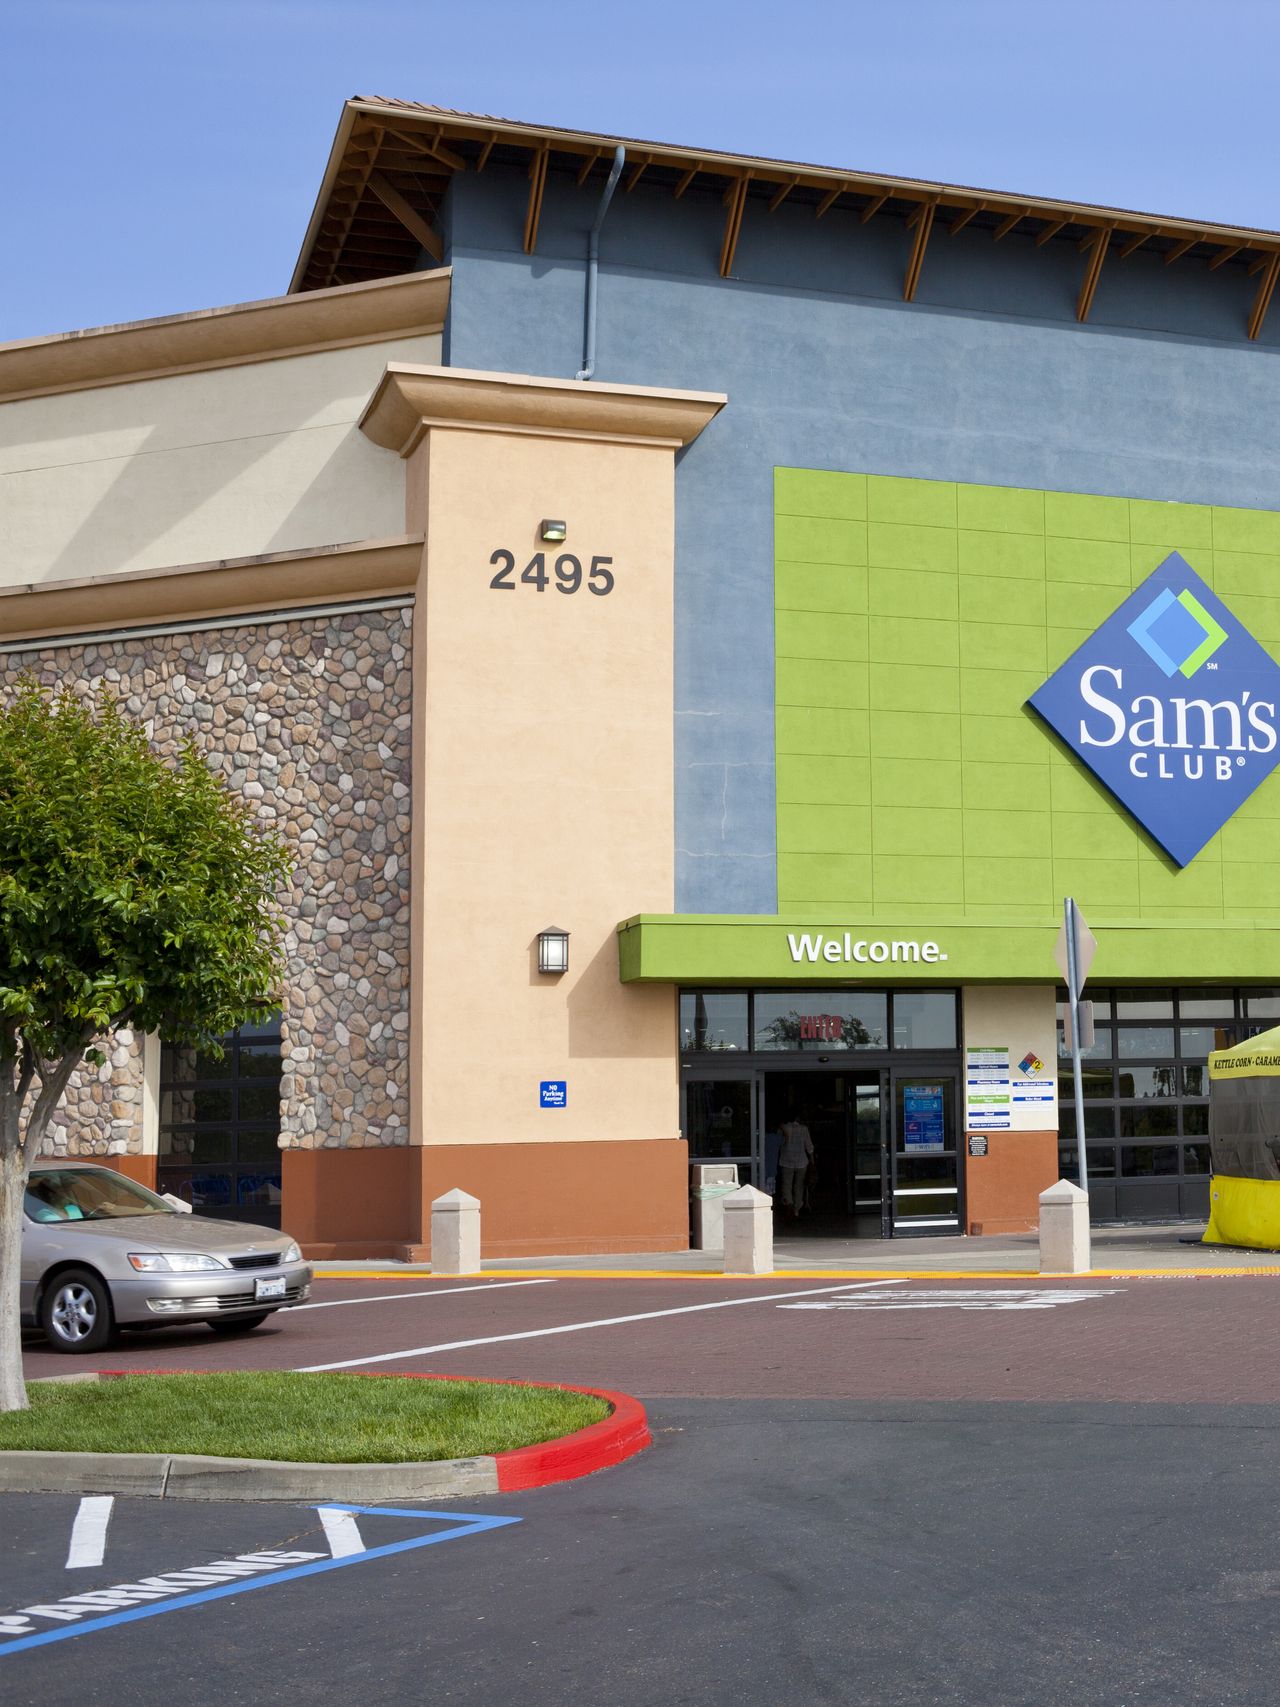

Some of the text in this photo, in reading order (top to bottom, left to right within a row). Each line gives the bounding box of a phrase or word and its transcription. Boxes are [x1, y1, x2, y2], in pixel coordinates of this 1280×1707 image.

[490, 549, 615, 596] 2495
[1080, 665, 1277, 753] Sam's
[1035, 1060, 1041, 1070] 2
[1214, 1059, 1235, 1070] KETTLE
[1235, 1057, 1252, 1067] CORN
[543, 1090, 564, 1098] Parking
[0, 1551, 330, 1634] PARKING
